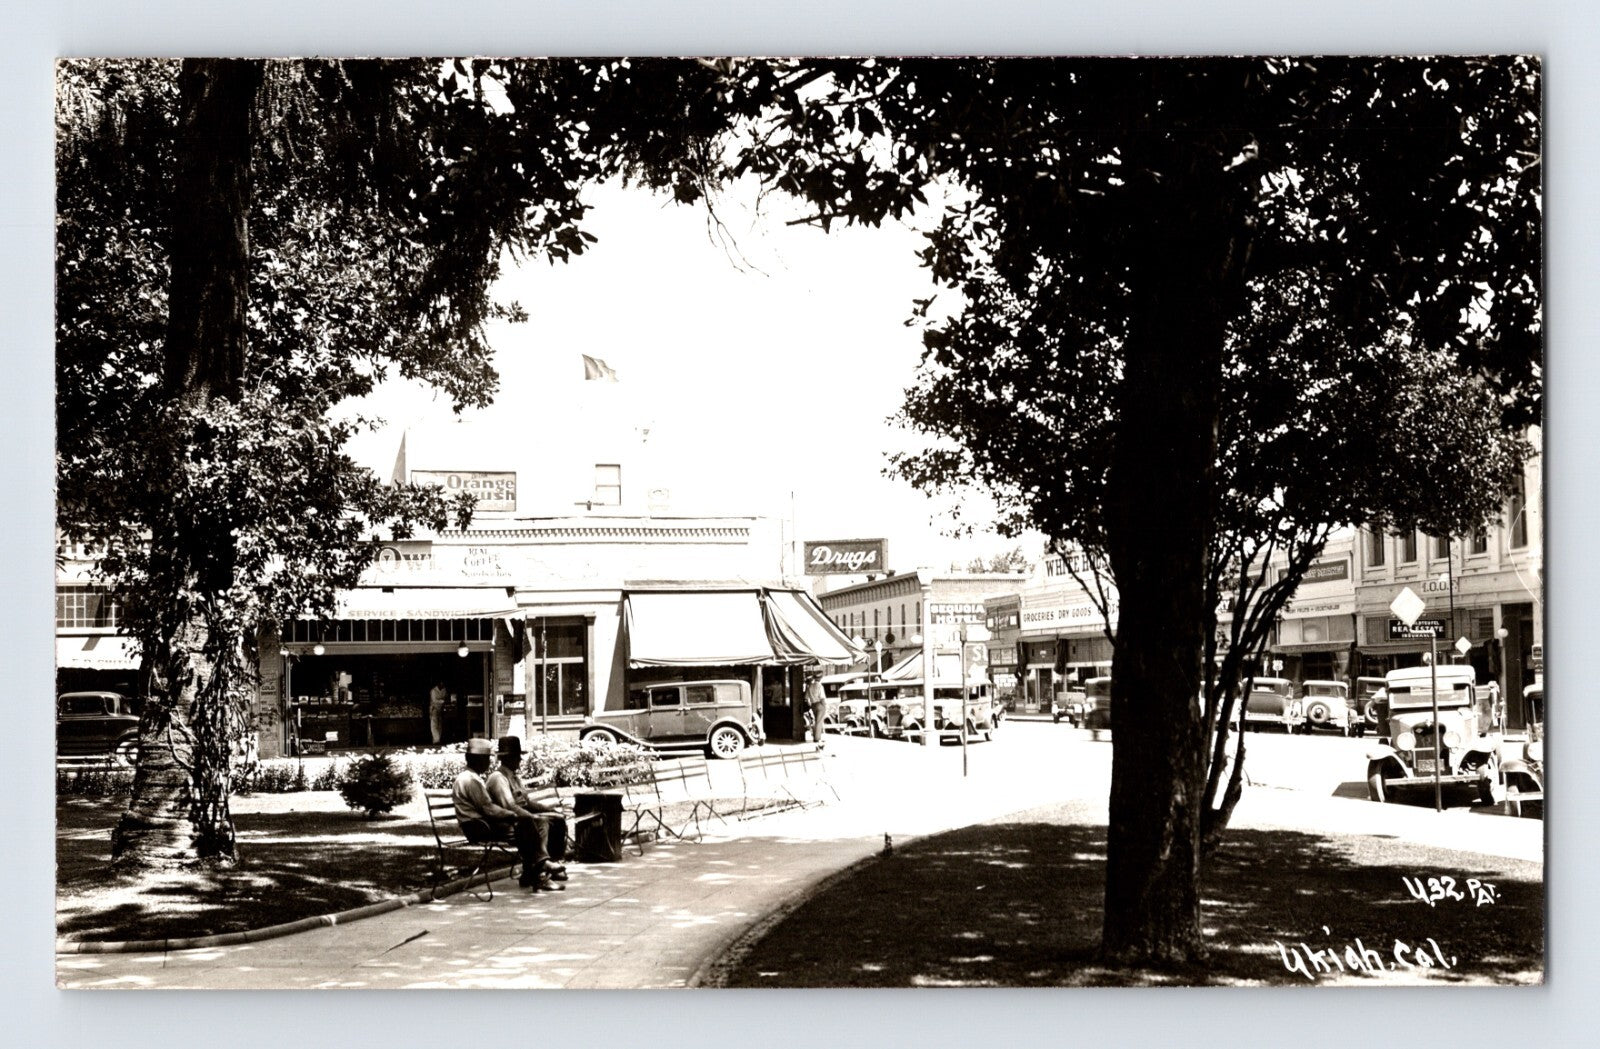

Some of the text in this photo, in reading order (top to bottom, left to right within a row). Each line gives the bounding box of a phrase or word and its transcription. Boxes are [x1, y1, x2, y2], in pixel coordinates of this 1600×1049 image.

[447, 474, 515, 494] Orange
[812, 546, 876, 570] Drugs
[347, 609, 396, 618] SERVICE
[1023, 611, 1054, 623] GROCERIES
[1058, 609, 1070, 620] DRY
[1071, 606, 1092, 618] GOODS
